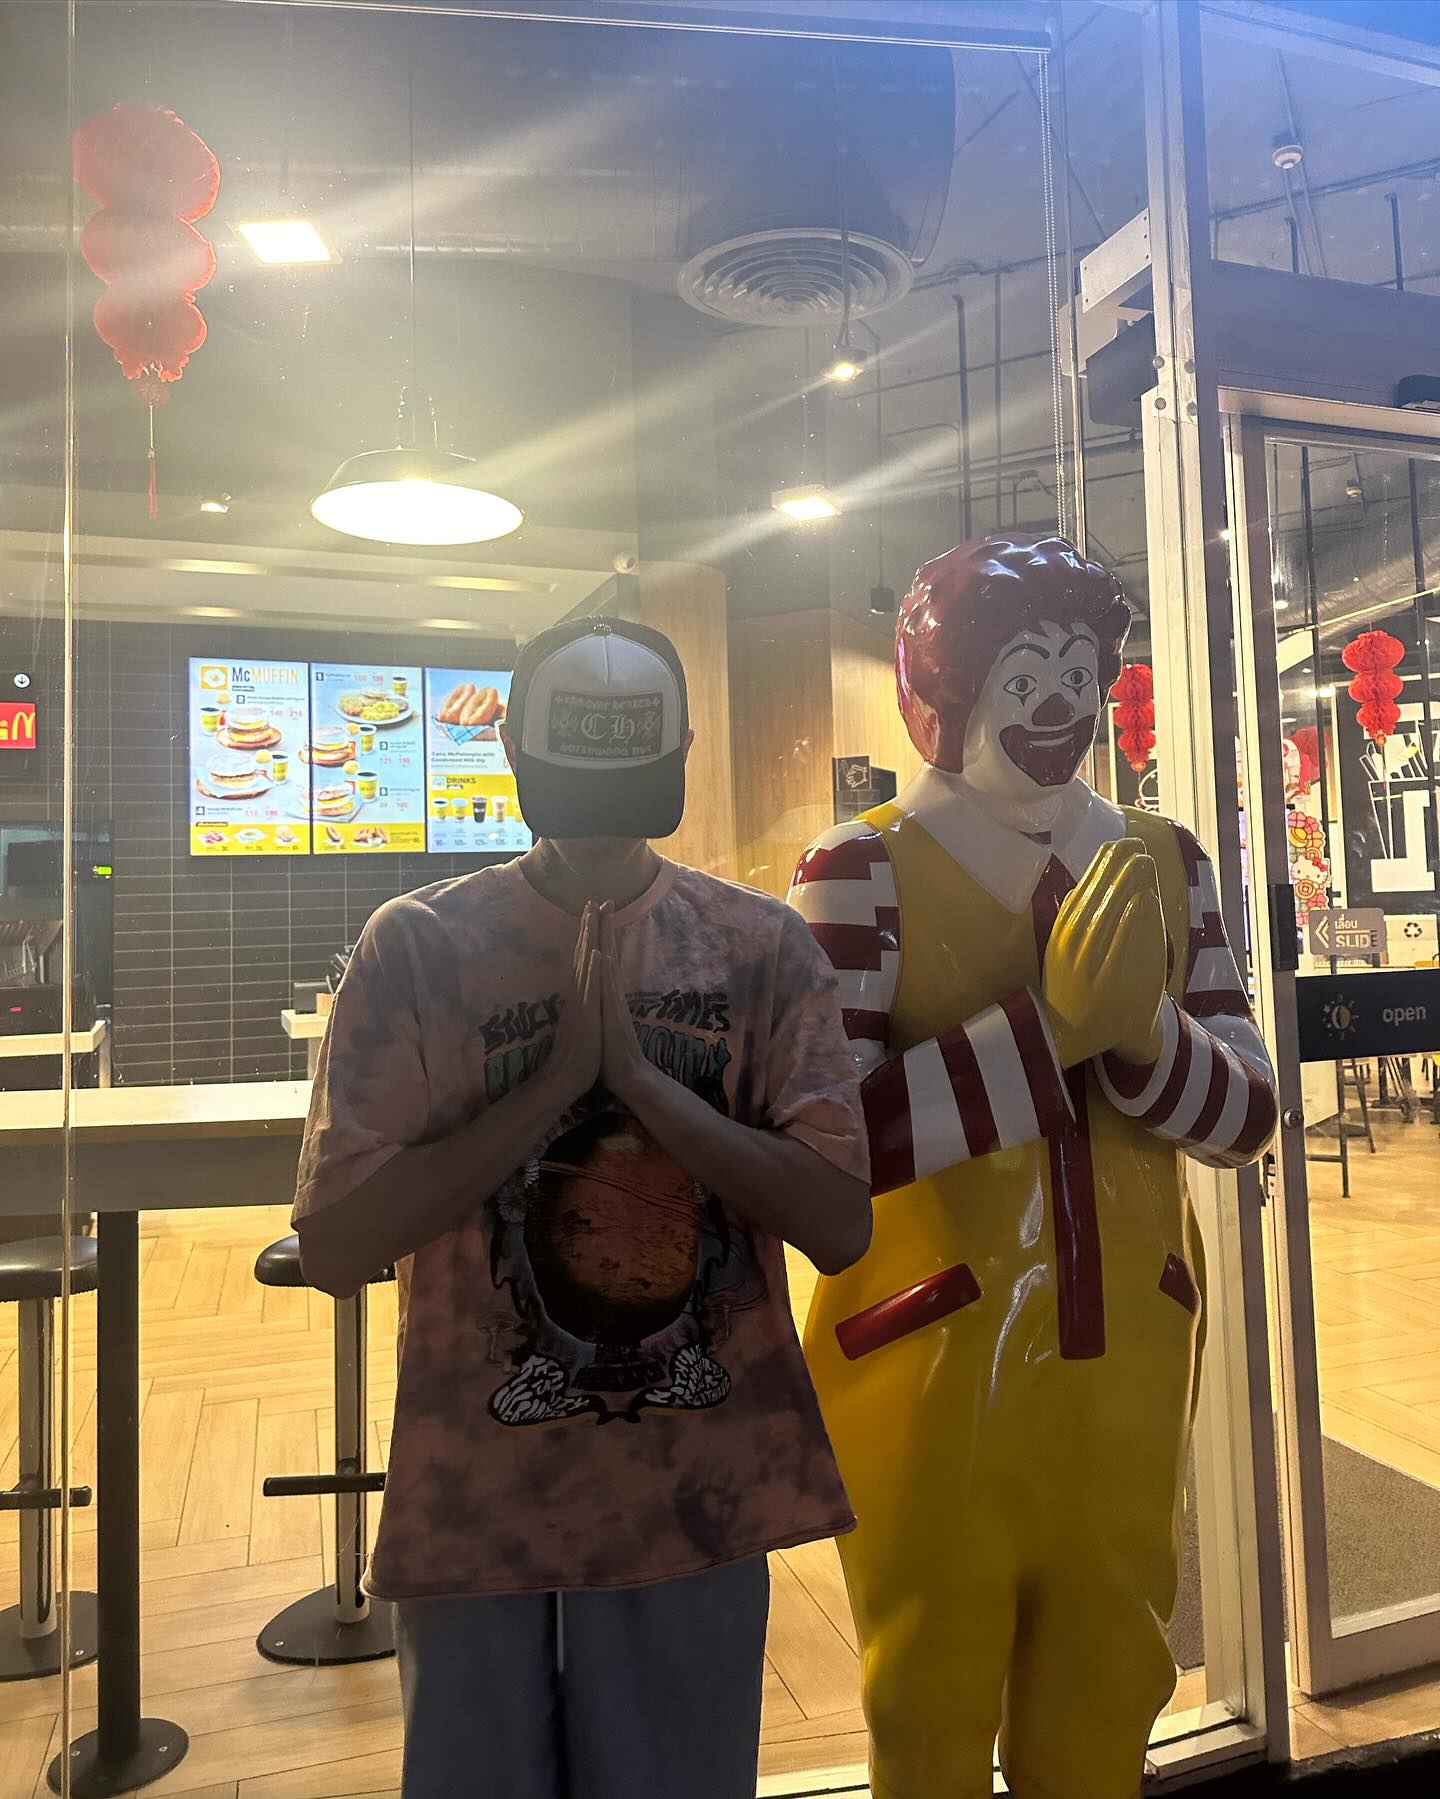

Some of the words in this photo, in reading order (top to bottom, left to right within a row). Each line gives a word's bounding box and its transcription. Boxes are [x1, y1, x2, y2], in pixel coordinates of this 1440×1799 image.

[231, 666, 298, 684] McMUFFIN
[1335, 914, 1358, 929] เลื่อน
[1336, 934, 1377, 948] SLIDE
[1383, 1006, 1427, 1026] open
